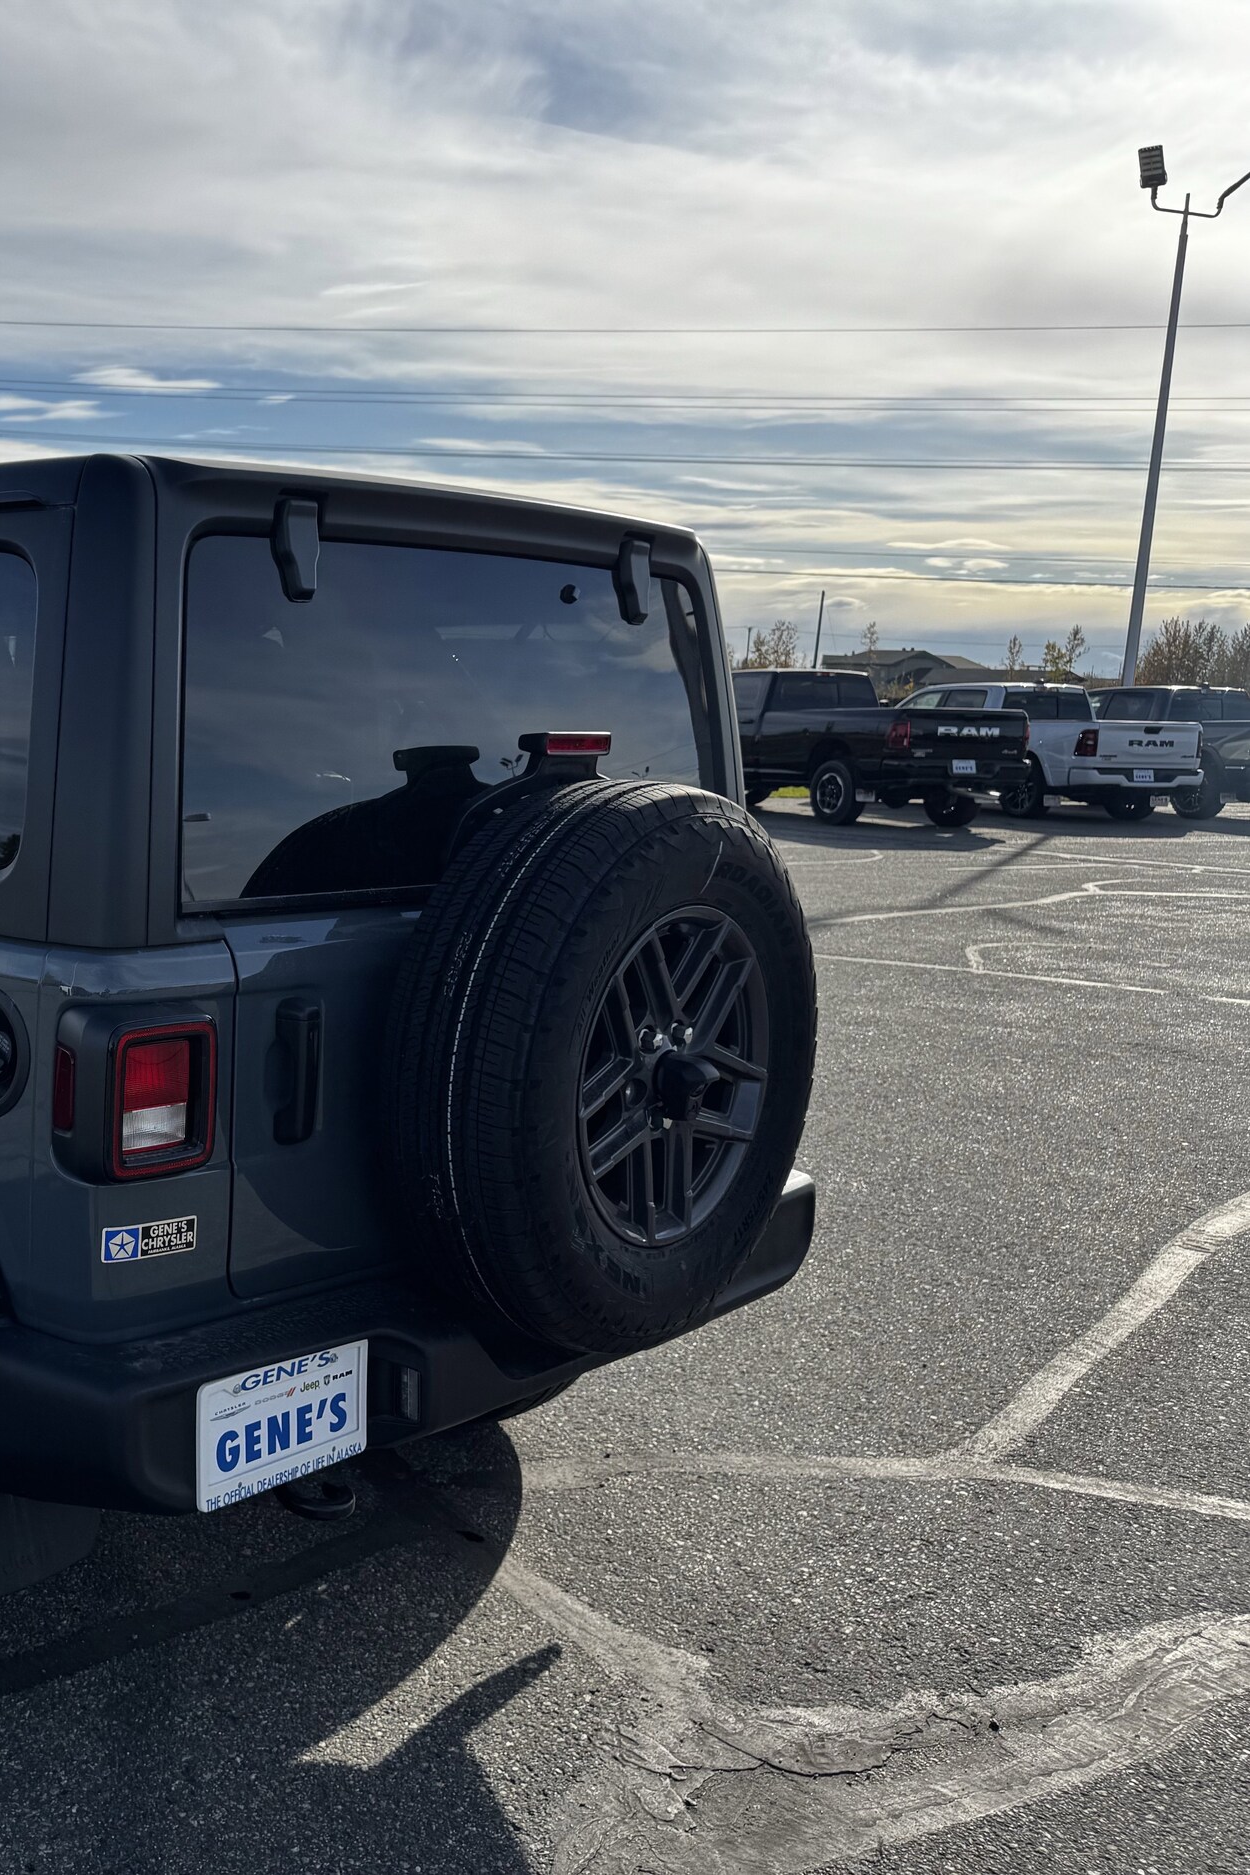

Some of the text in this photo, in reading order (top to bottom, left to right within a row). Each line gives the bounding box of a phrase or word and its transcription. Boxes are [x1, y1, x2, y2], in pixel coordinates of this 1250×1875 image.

[937, 726, 1000, 738] RAM
[1128, 739, 1175, 748] RAM
[150, 1221, 187, 1238] GENE'S
[141, 1231, 194, 1250] CHRYSLER
[240, 1351, 331, 1392] GENE'S
[332, 1369, 353, 1381] RAM
[300, 1380, 320, 1393] Jeep
[214, 1402, 246, 1416] CHRYSLER
[216, 1392, 347, 1473] GENE'S
[206, 1442, 362, 1511] THE OFFICIAL DEALERSHIP OF LIFE IN ALASKA
